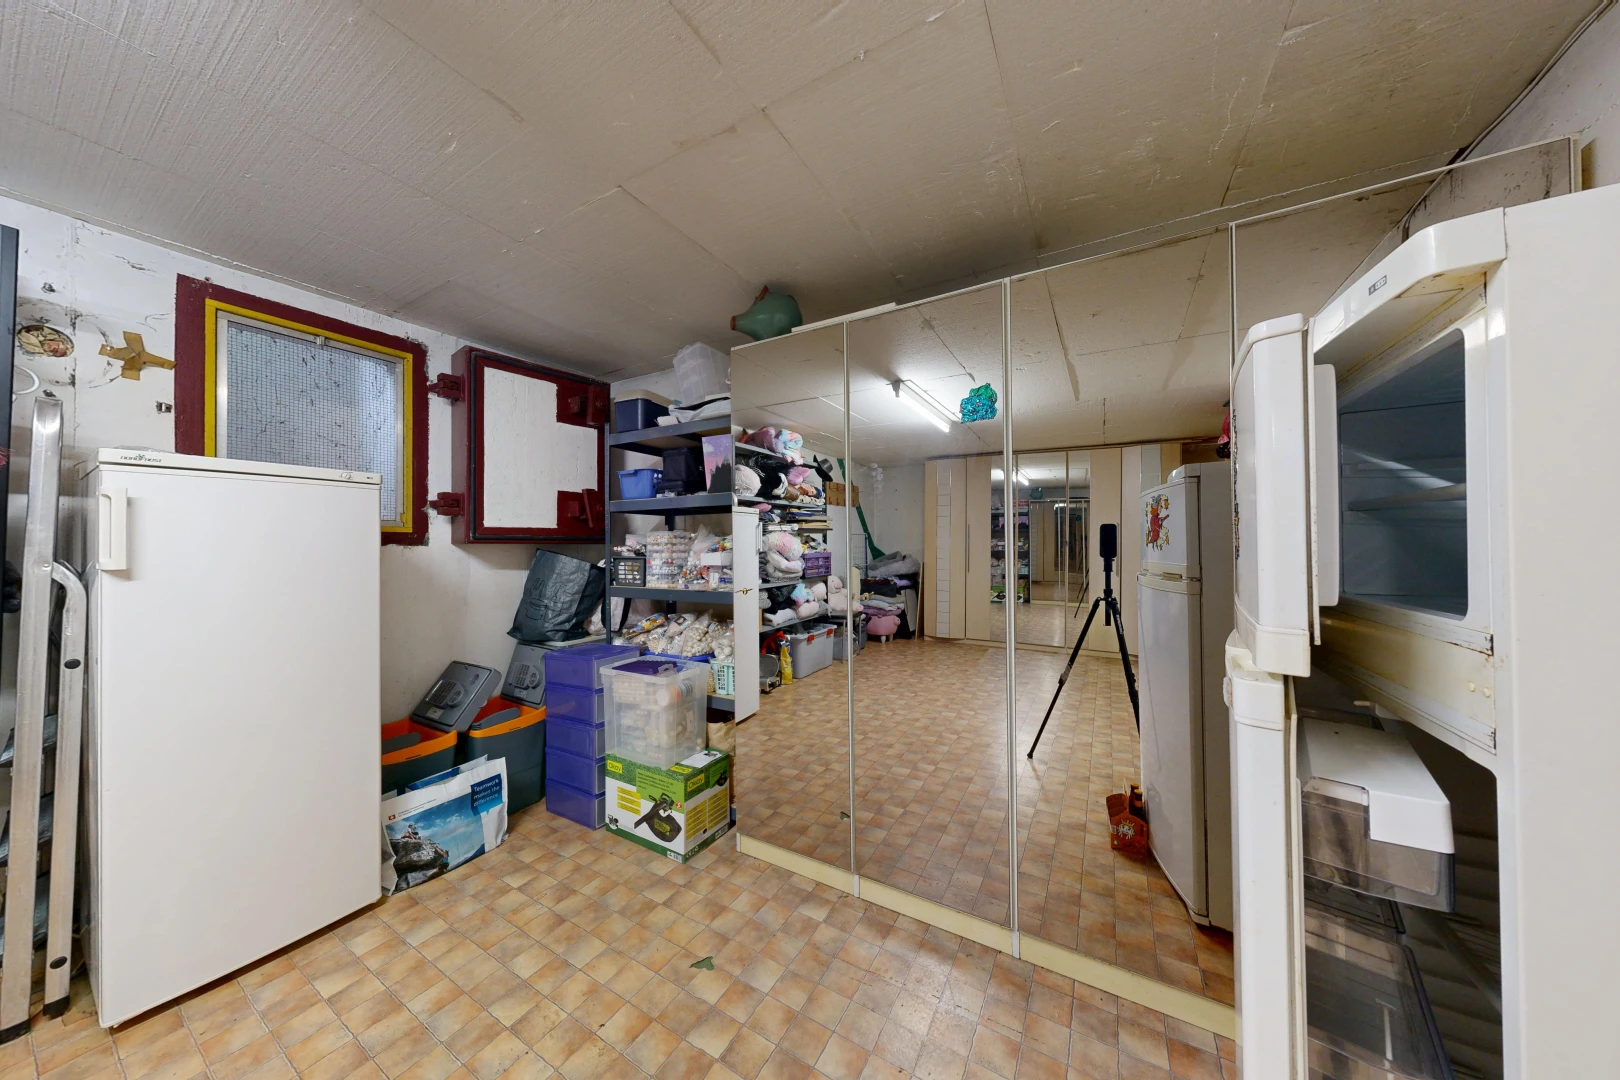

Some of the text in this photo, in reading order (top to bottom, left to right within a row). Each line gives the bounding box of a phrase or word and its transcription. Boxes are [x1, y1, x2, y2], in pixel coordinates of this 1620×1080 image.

[474, 779, 499, 792] Teamwork
[473, 789, 491, 799] makes
[473, 793, 499, 807] difference
